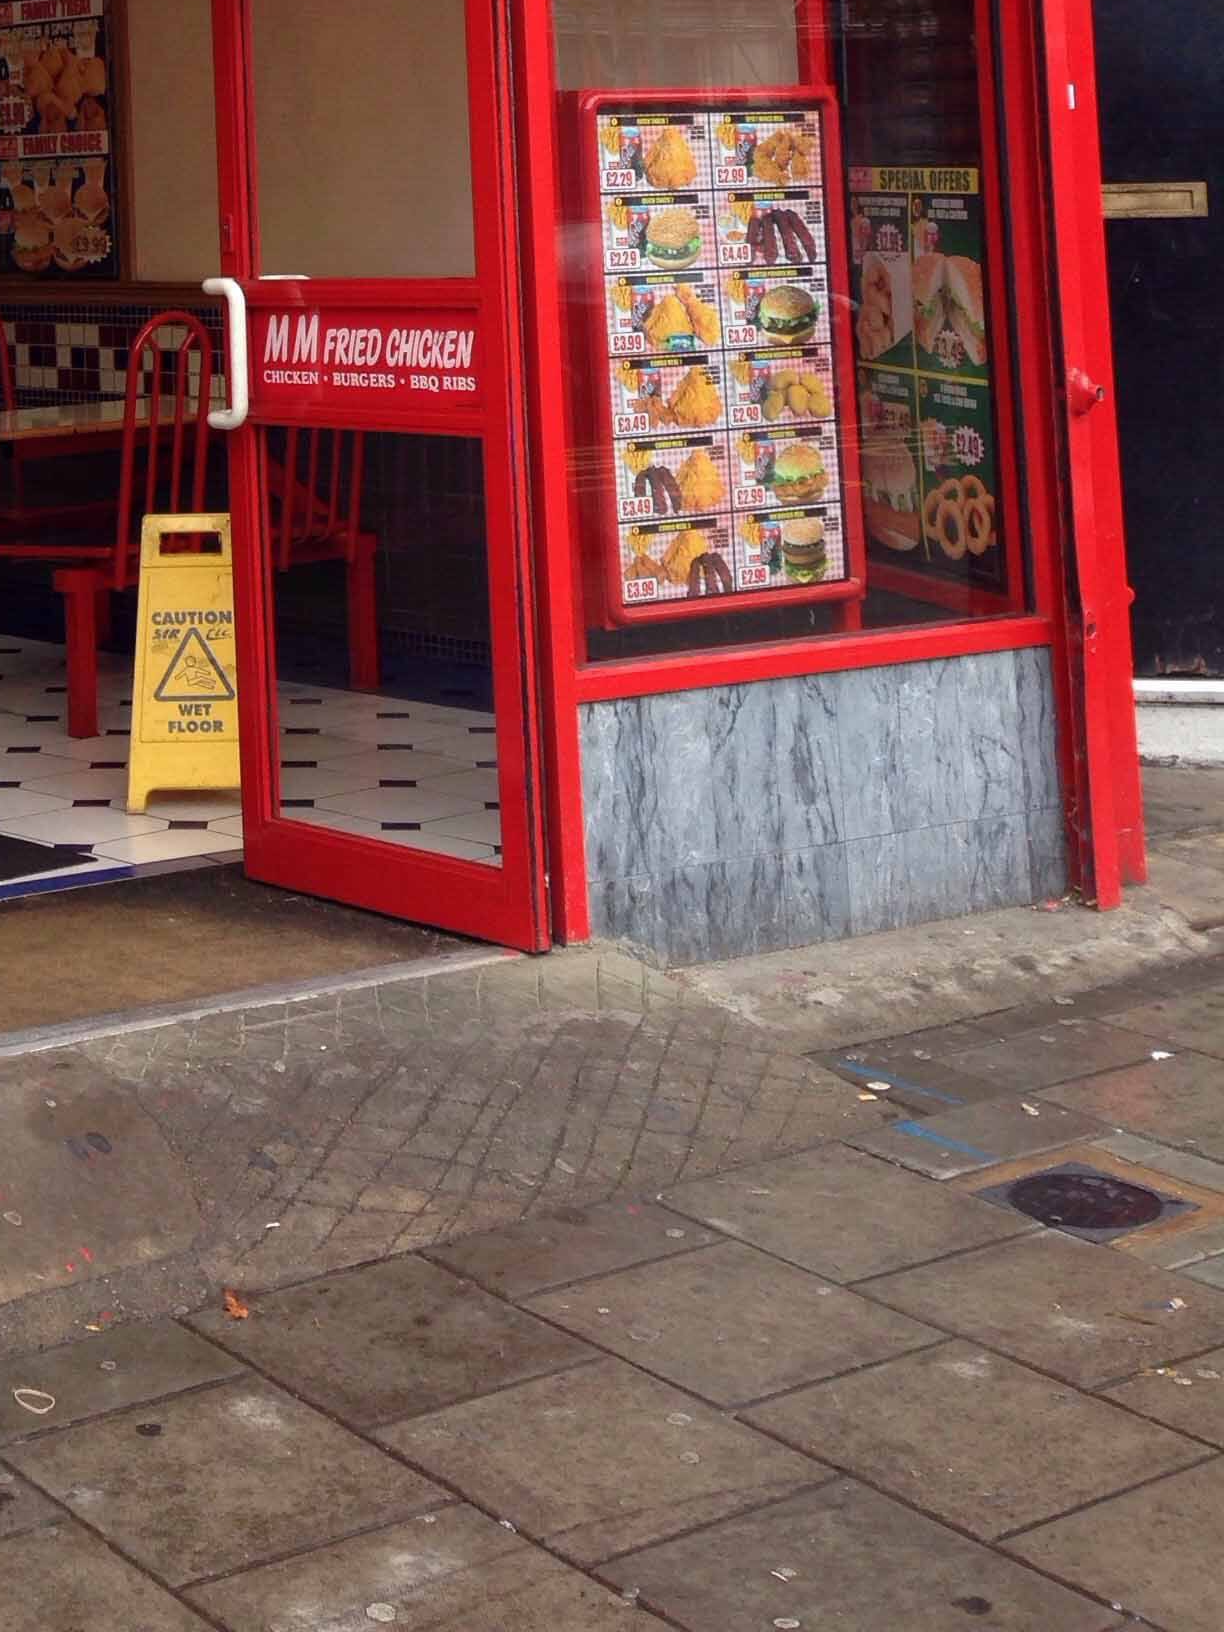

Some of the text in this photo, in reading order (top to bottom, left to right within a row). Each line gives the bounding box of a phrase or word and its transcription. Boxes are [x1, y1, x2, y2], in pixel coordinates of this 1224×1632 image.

[879, 169, 971, 192] SPECIAL OFFERS
[263, 314, 475, 369] M M FRIED CHICKEN
[263, 370, 476, 392] CHICKEN BURGERS BBQ RIBS
[151, 610, 233, 626] CAUTION
[178, 704, 212, 717] WET
[167, 720, 225, 734] FLOOR
